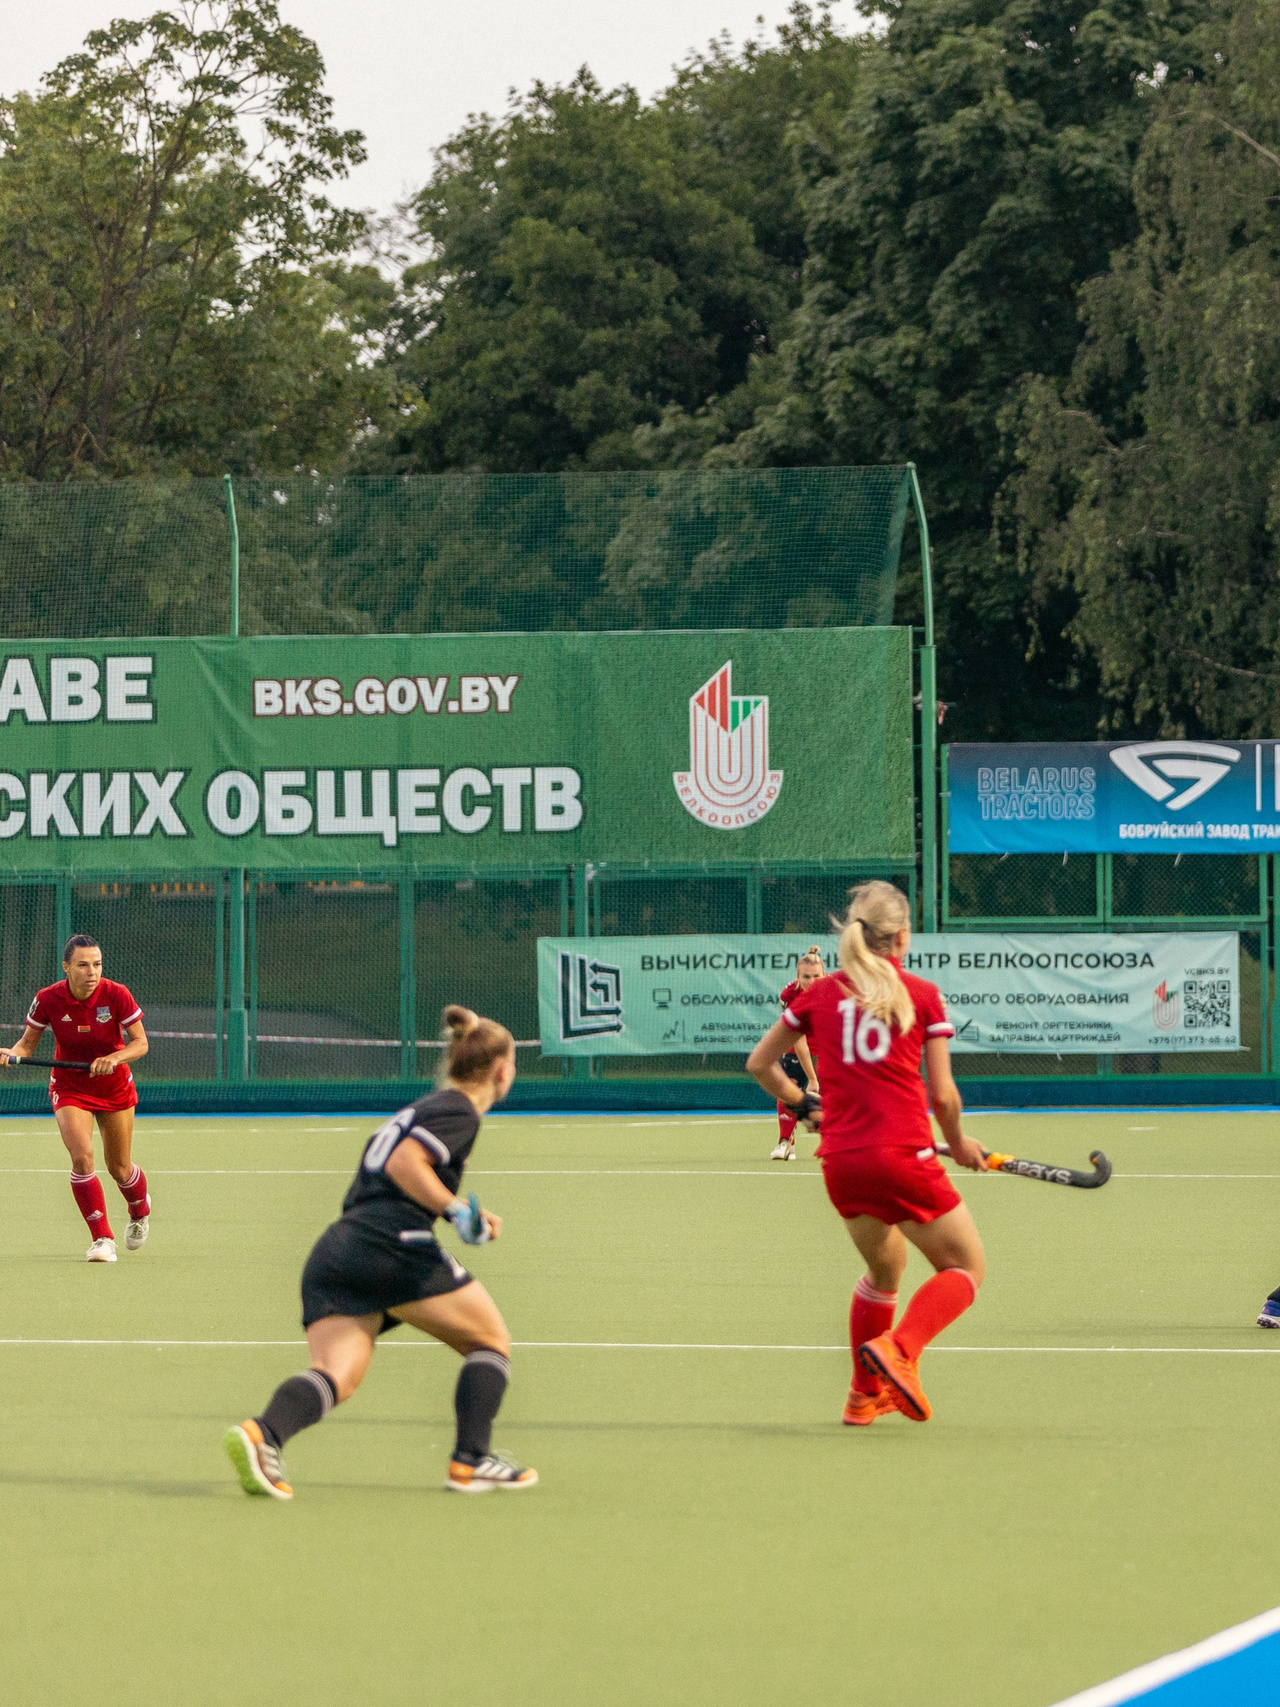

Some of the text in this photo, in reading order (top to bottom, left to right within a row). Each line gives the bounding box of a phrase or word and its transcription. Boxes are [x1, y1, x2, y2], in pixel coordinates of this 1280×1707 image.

[0, 656, 155, 722] АВЕ
[252, 675, 522, 717] BKS.GOV.BY
[978, 767, 1096, 793] BELARUS
[206, 767, 584, 847] ОБЩЕСТВ
[978, 793, 1096, 820] TRACTORS
[1119, 821, 1204, 839] БОБРУЙСКИЙ
[1207, 824, 1250, 840] ЗАВОД
[958, 952, 1155, 969] БЕЛКООПСОЮЗА
[1005, 993, 1129, 1006] ОБОРУДОВАНИЯ
[701, 1022, 772, 1031] АВТОМАТИЗА
[838, 997, 891, 1064] 16
[996, 1021, 1038, 1030] РЕМОНТ
[693, 1034, 761, 1044] БИЗНЕС-ПРО
